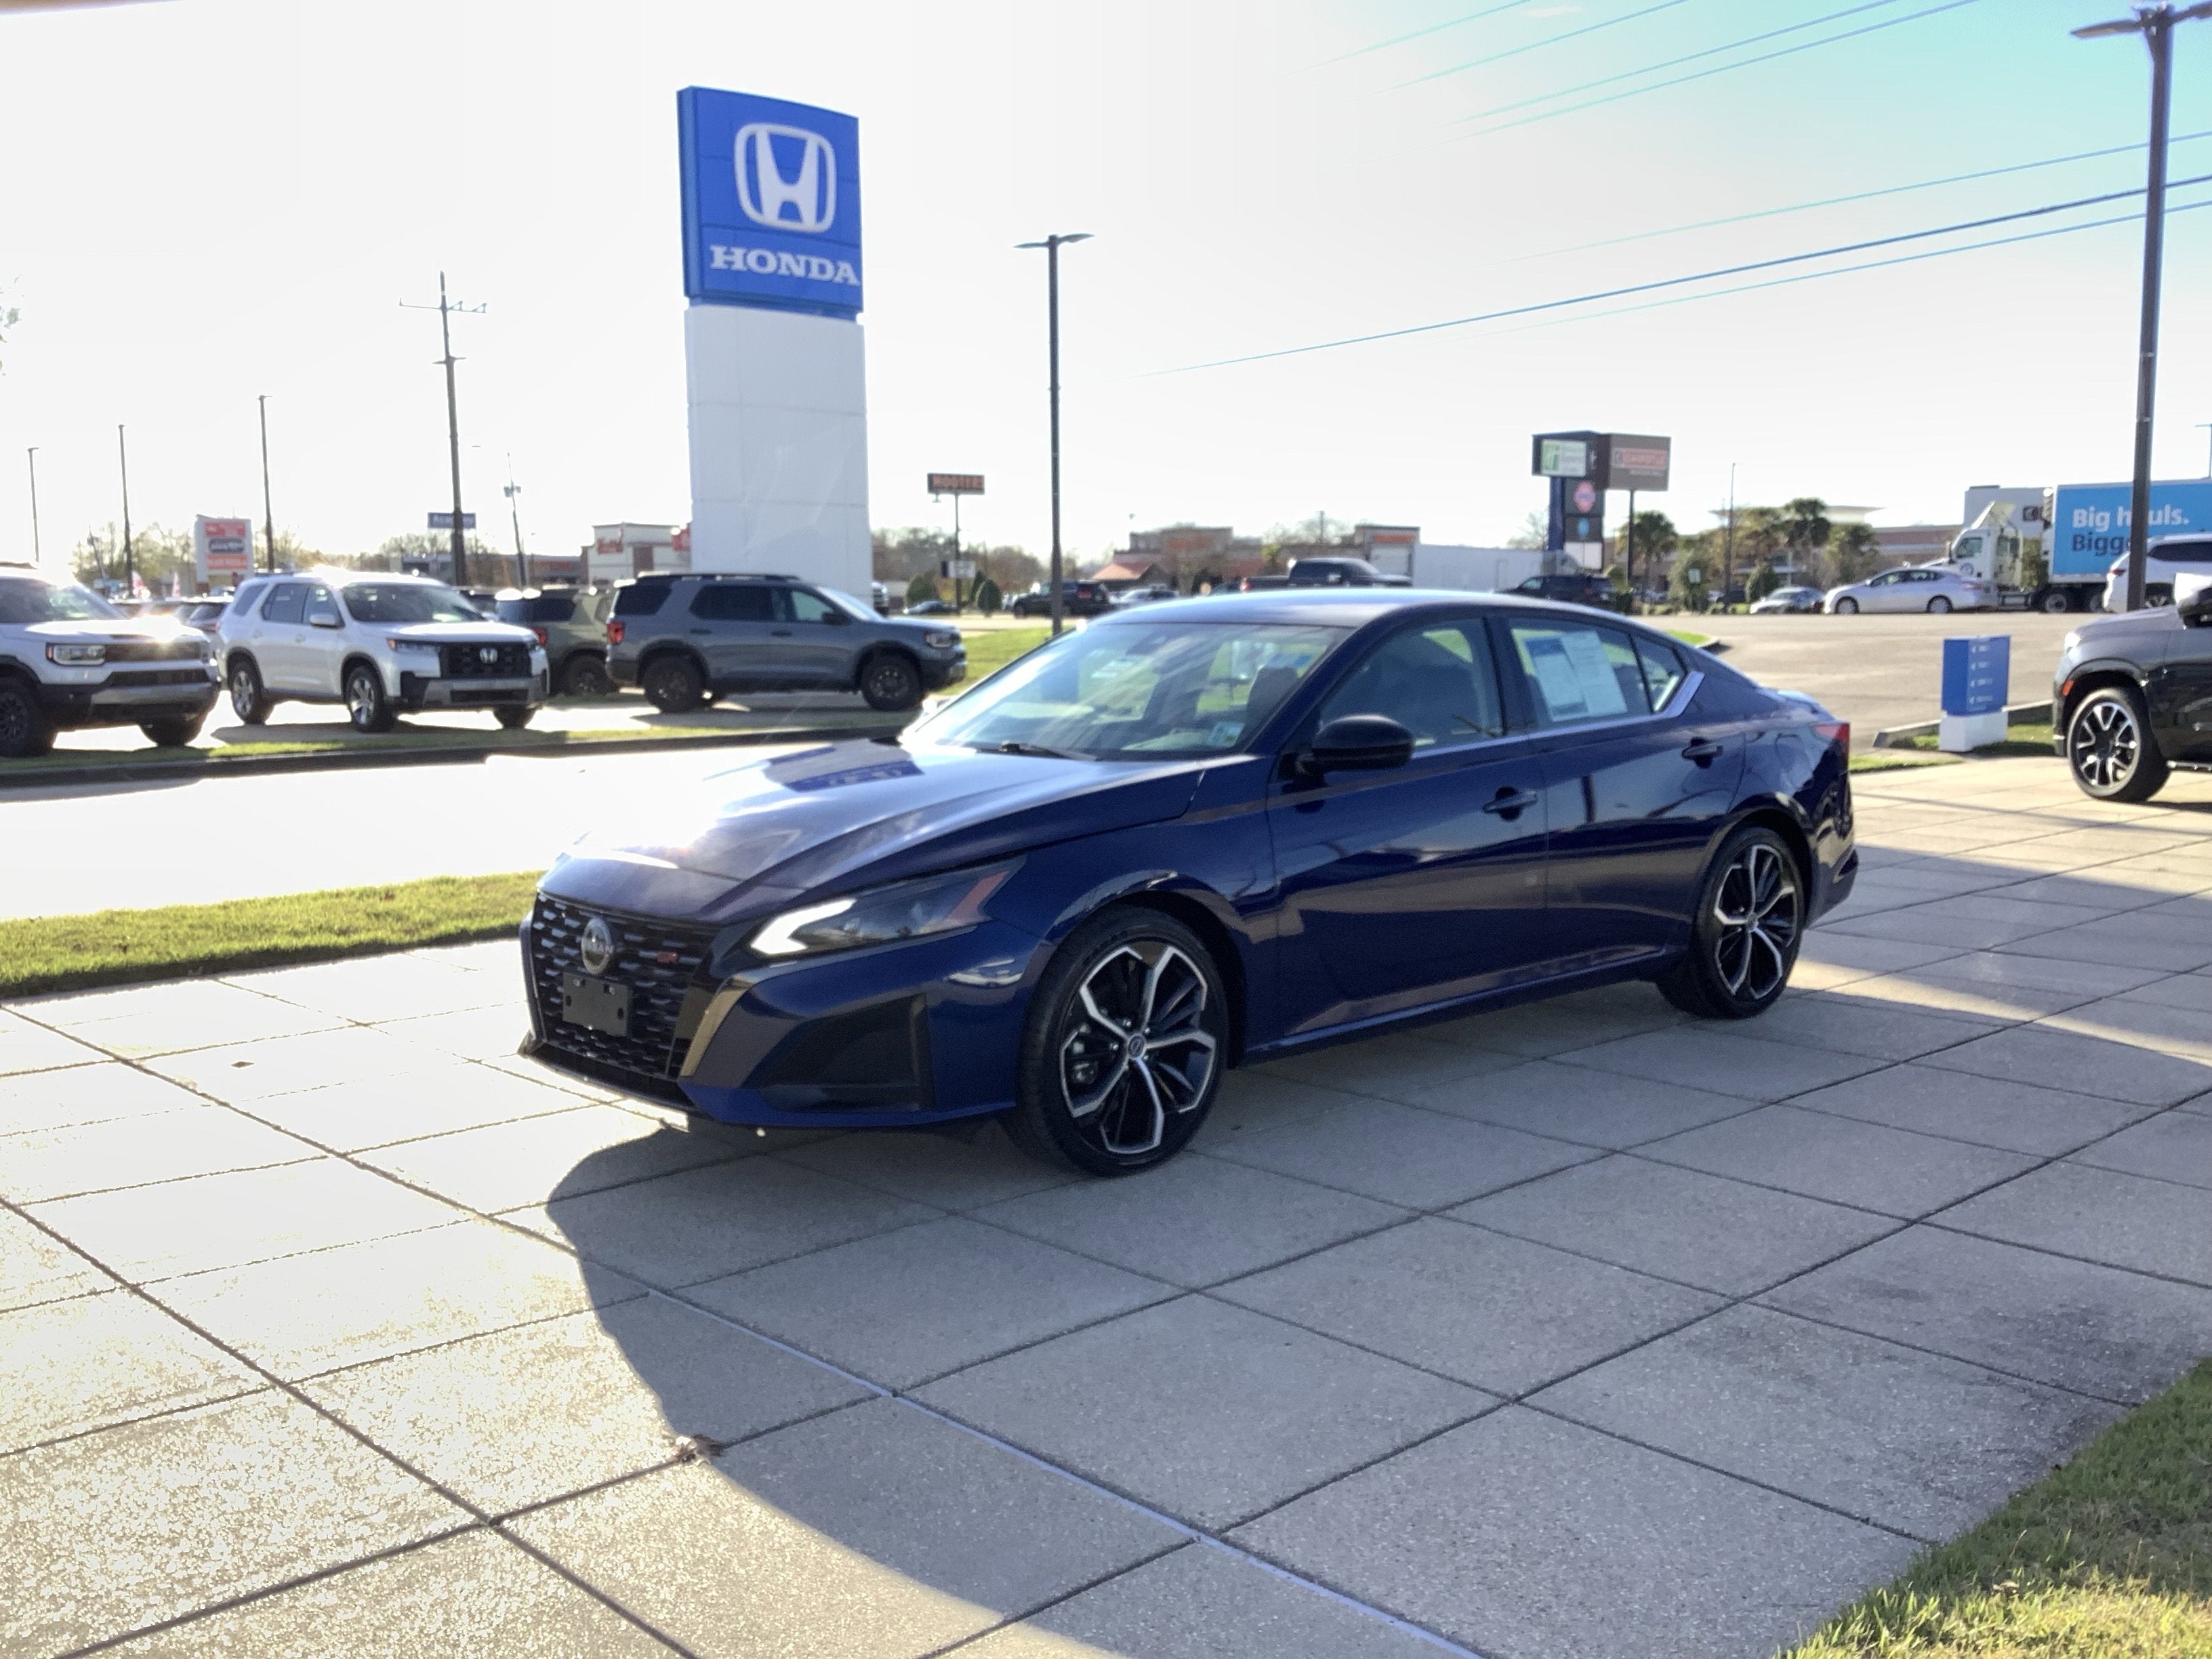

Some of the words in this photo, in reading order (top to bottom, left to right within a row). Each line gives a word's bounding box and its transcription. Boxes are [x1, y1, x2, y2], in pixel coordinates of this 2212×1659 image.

[710, 245, 861, 287] HONDA
[2072, 506, 2110, 532] Big
[2116, 504, 2190, 527] huls.
[2071, 532, 2131, 556] Bigg
